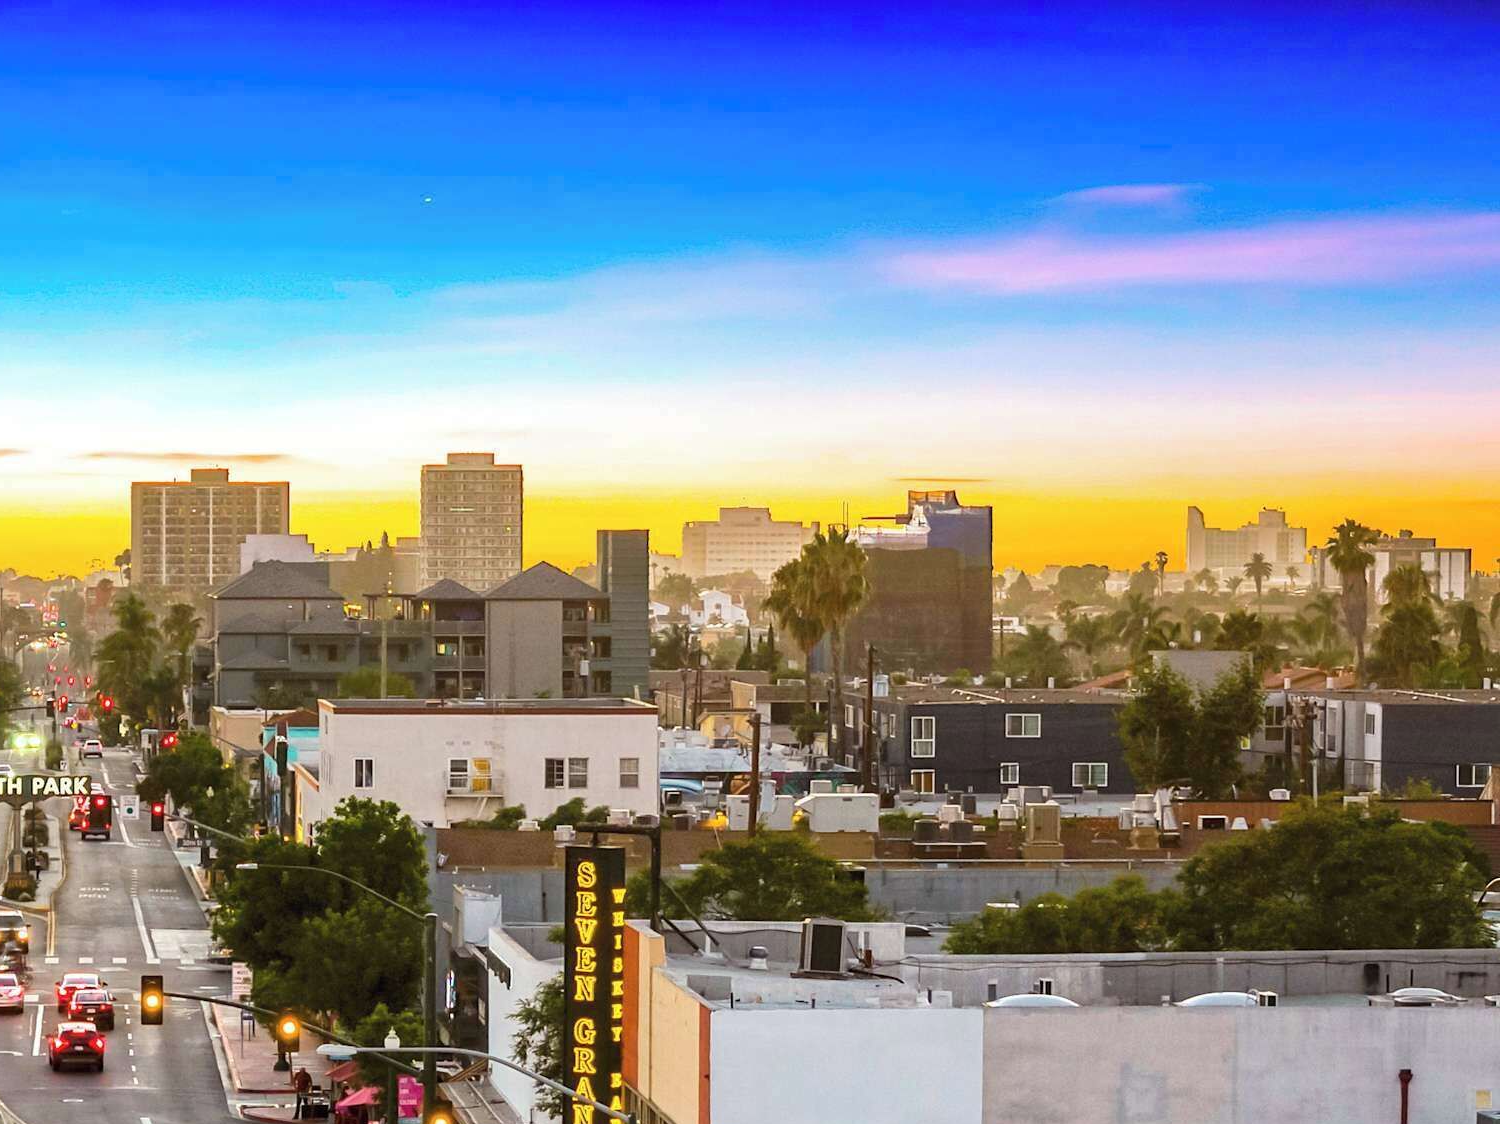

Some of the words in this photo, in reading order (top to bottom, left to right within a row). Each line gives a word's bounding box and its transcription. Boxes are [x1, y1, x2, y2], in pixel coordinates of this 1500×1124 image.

[32, 777, 88, 795] PARK
[573, 861, 598, 1003] SEVEN
[611, 887, 627, 1043] WHISKEY
